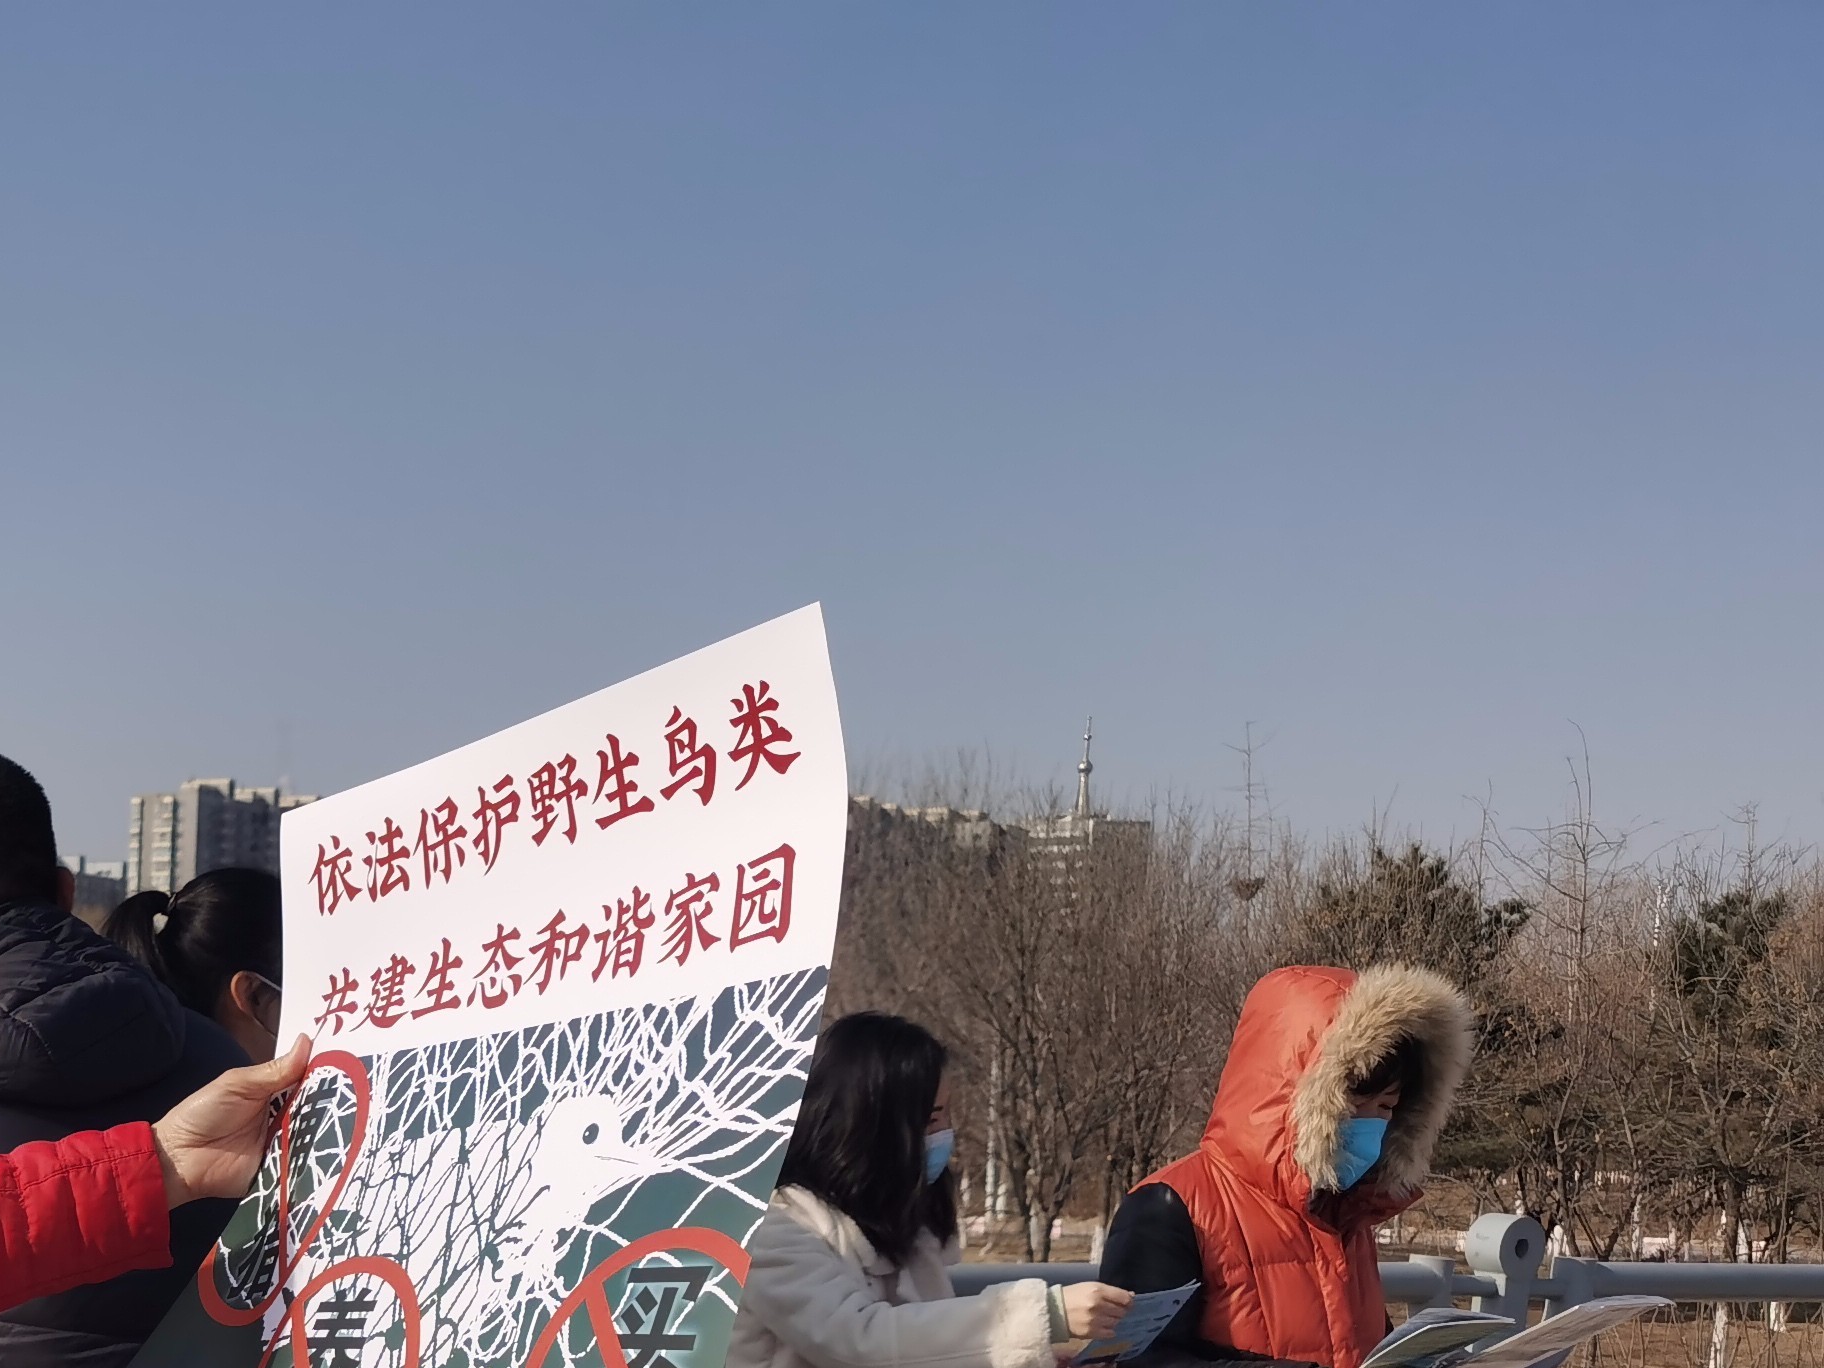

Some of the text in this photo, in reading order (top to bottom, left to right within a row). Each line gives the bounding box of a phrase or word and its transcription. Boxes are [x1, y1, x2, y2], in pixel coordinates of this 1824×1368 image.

[308, 680, 801, 917] 依法保护野生鸟类
[313, 843, 796, 1036] 共建生态和谐家园
